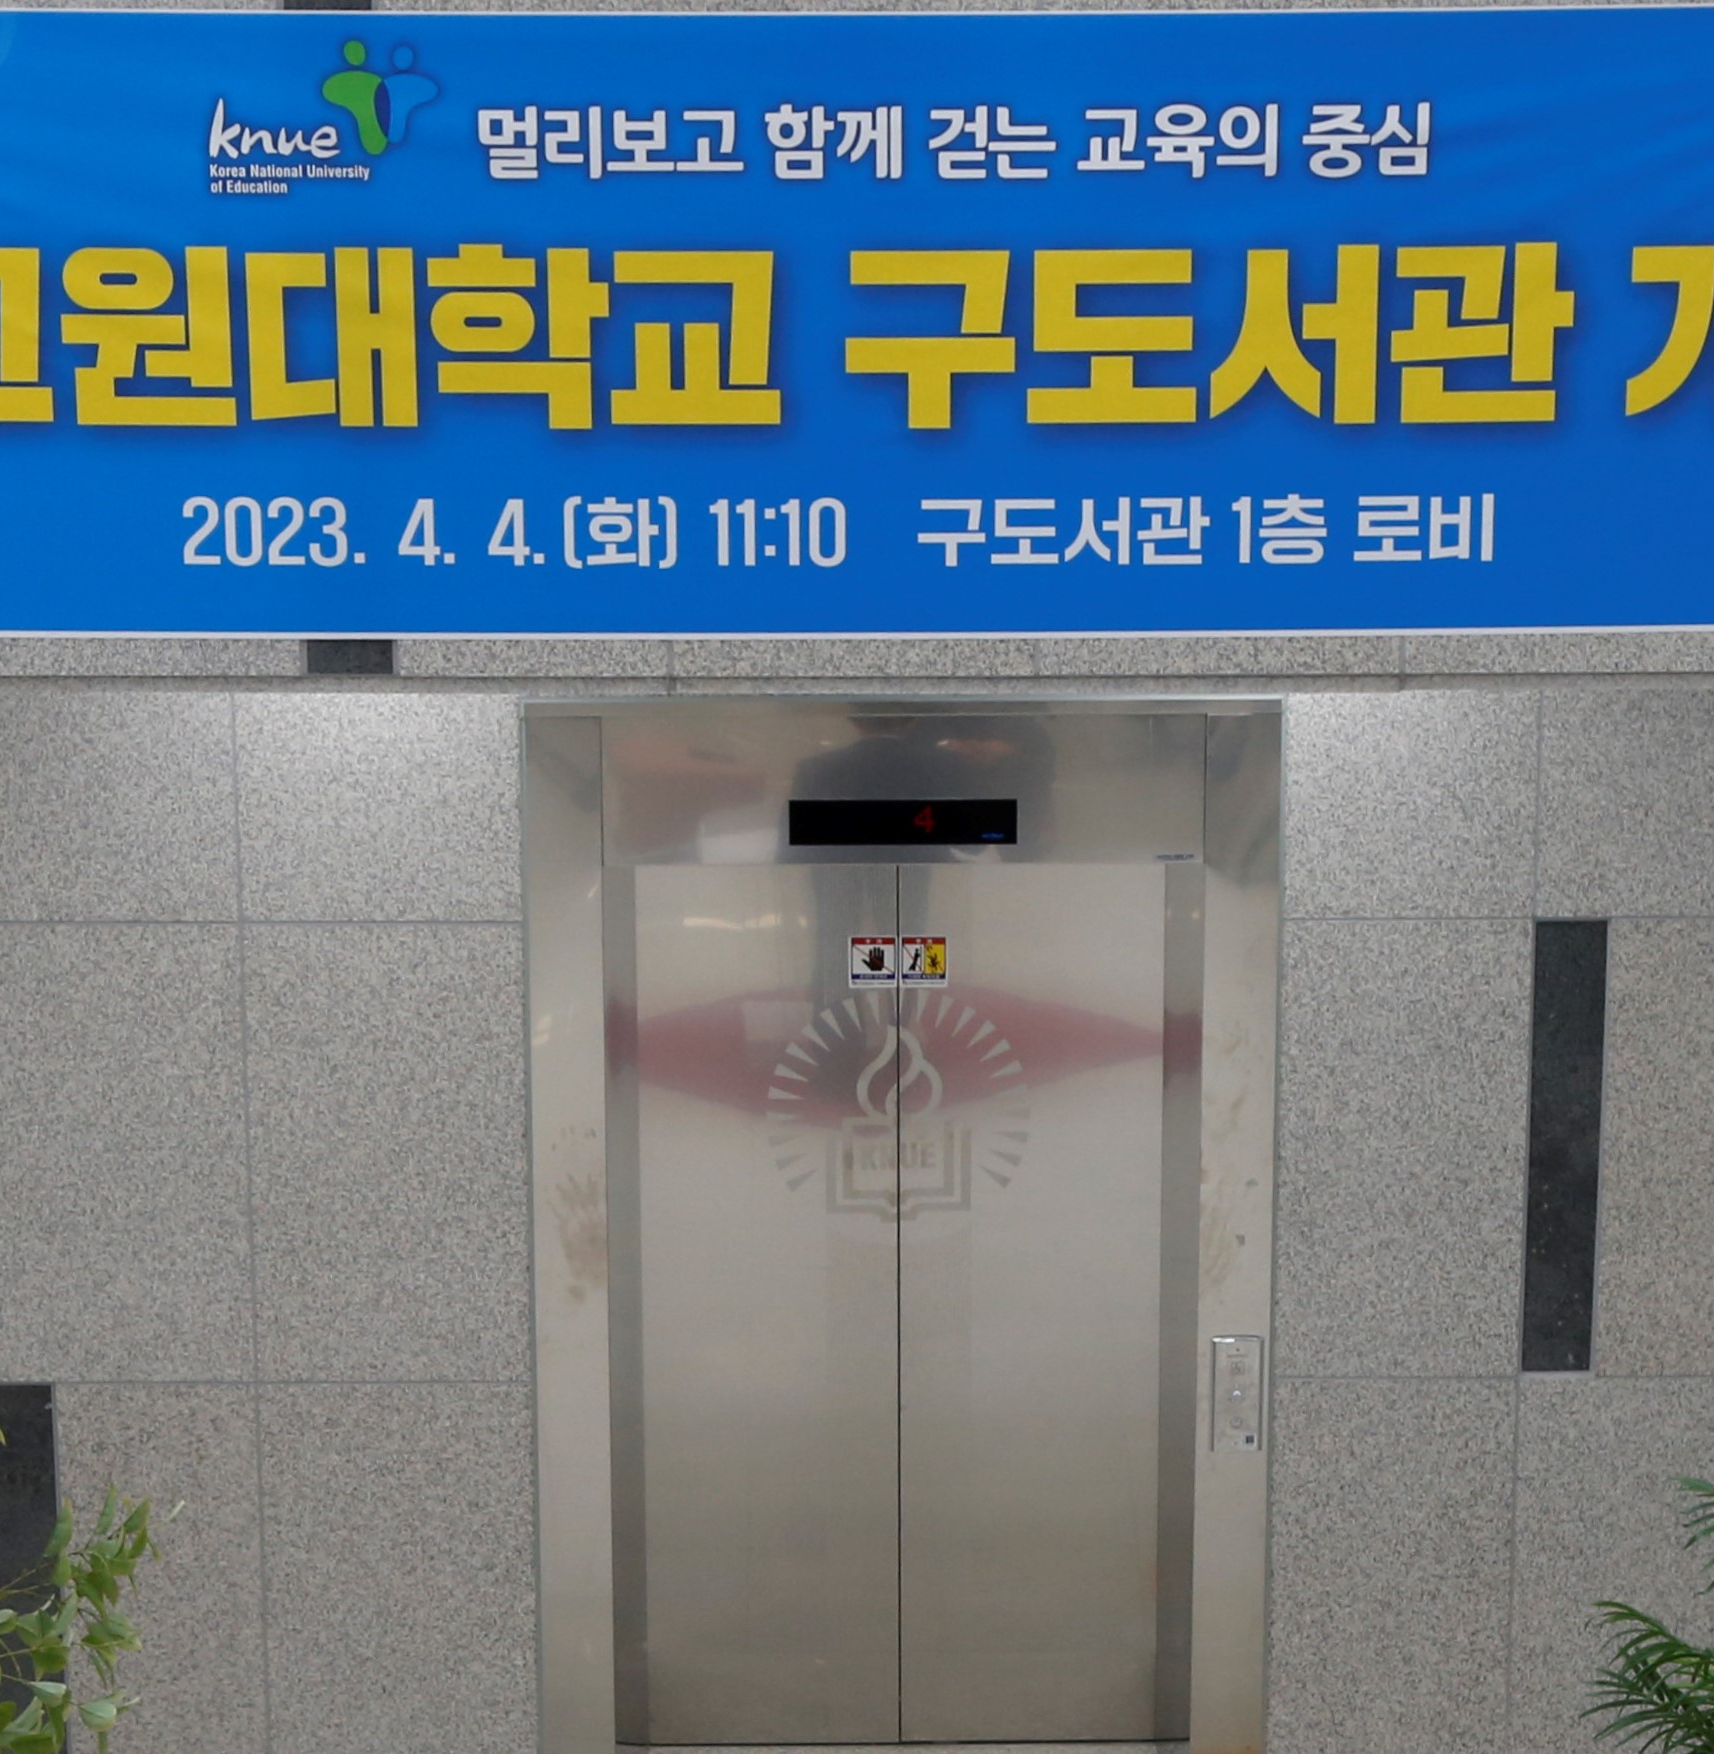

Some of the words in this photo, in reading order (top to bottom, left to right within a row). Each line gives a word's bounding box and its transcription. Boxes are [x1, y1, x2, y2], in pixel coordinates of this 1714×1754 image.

[208, 98, 340, 160] knue
[477, 105, 745, 180] 멀리보고
[764, 103, 903, 180] 함께
[928, 105, 1057, 180] 걷는
[1077, 103, 1279, 179] 교육의
[1302, 101, 1432, 178] 중심
[209, 163, 246, 178] Korea
[250, 163, 303, 179] National
[306, 163, 370, 181] University
[210, 180, 223, 194] of
[226, 180, 288, 194] Education
[844, 240, 1575, 430] 구도서관
[181, 496, 366, 567] 2023.
[397, 498, 455, 566] 4.
[709, 497, 846, 567] 11:10
[917, 496, 1211, 567] 구도서관
[1231, 493, 1328, 564] 1층
[1353, 493, 1495, 563] 로비
[914, 805, 935, 833] 4
